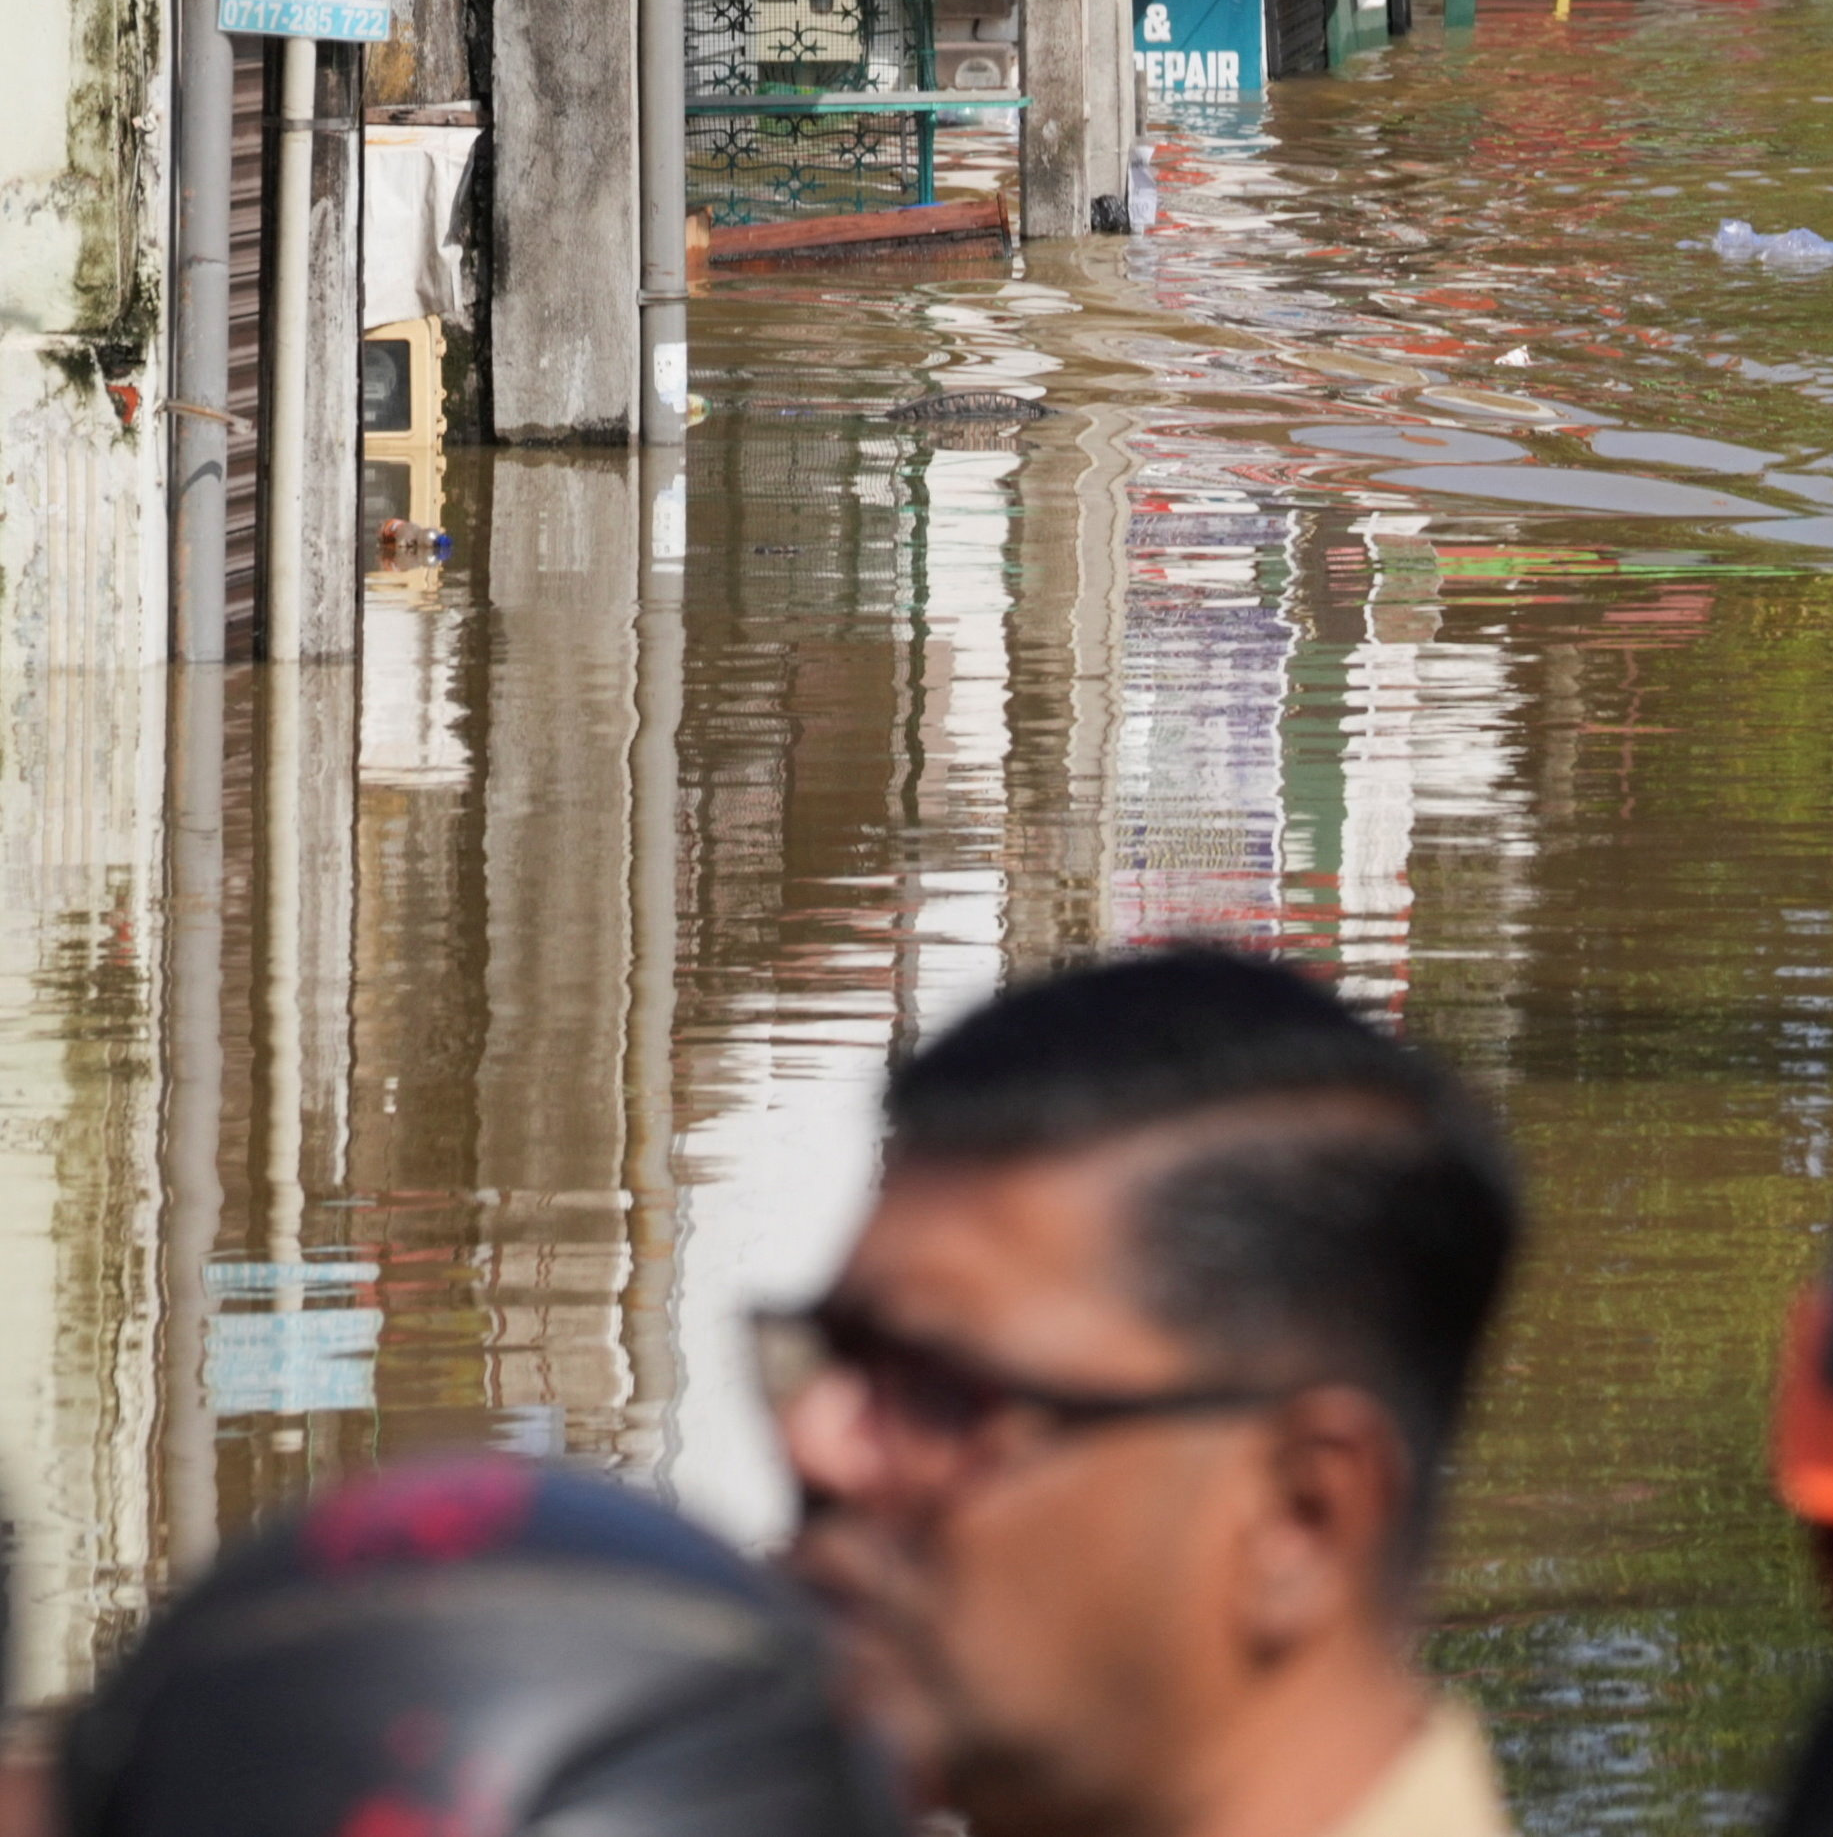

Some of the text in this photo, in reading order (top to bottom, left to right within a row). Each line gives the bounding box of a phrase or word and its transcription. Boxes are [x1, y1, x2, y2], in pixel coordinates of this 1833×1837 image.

[223, 0, 384, 37] 0717-285 722
[1144, 4, 1171, 42] &
